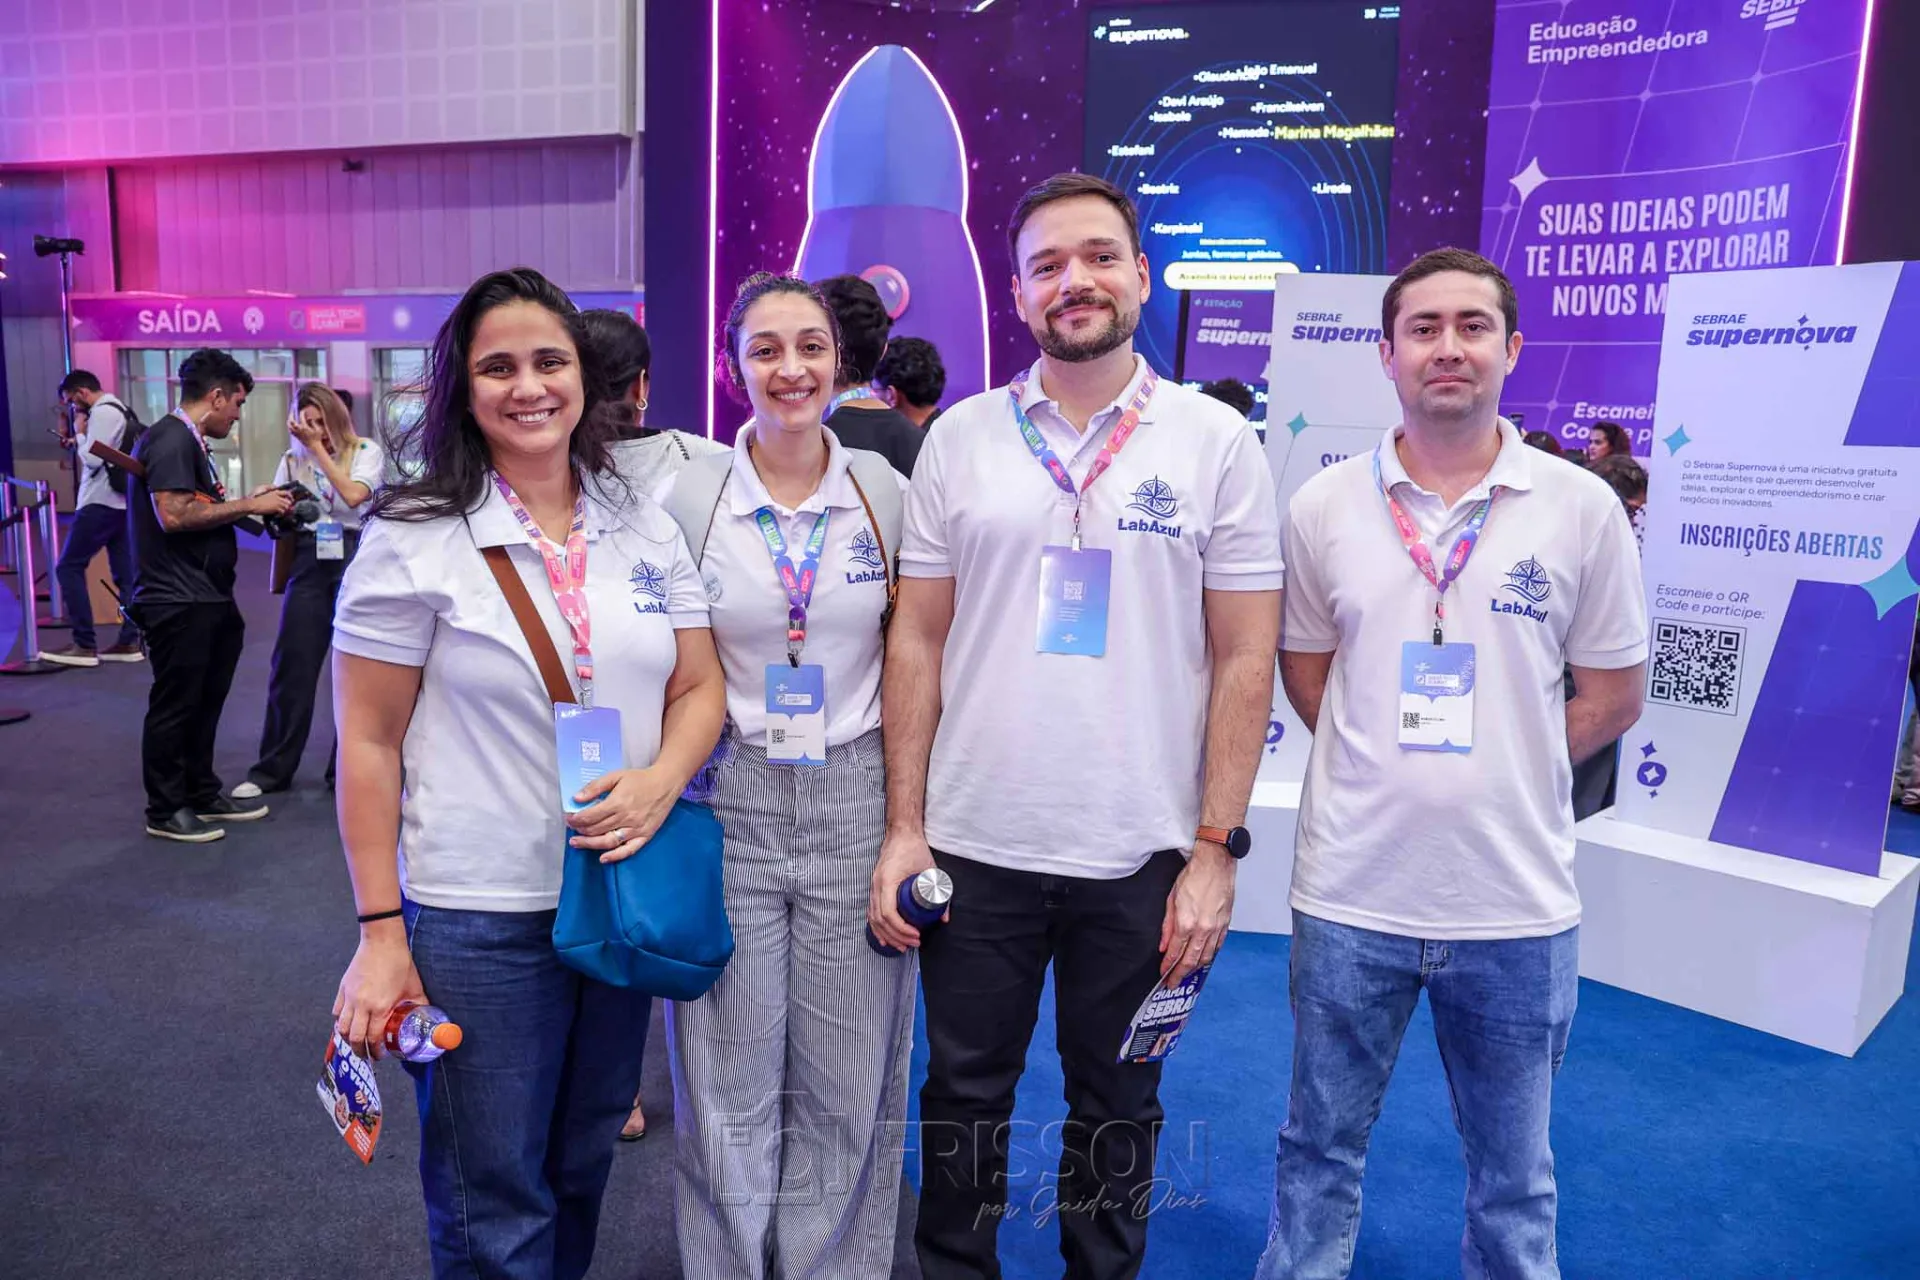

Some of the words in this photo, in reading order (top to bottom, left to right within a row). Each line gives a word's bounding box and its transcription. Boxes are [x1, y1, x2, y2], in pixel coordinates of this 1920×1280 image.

[1529, 16, 1637, 41] Educação
[1527, 30, 1708, 64] Empreendedora
[1274, 125, 1321, 140] Marina
[1538, 202, 1604, 237] SUAS
[1610, 196, 1694, 234] IDEIAS
[1701, 183, 1790, 228] PODEM
[1525, 245, 1551, 277] TE
[1557, 242, 1634, 277] LEVAR
[1640, 241, 1657, 274] A
[1665, 228, 1790, 273] EXPLORAR
[1552, 283, 1637, 317] NOVOS
[138, 304, 222, 334] SAÍDA
[1296, 312, 1343, 323] SEBRAE
[1693, 313, 1747, 324] SEBRAE
[1686, 325, 1857, 348] supernova
[1682, 473, 1702, 482] para
[1703, 472, 1753, 483] estudantes
[1755, 476, 1774, 485] que
[1776, 477, 1813, 487] querem
[1815, 478, 1875, 489] desenvolver
[1693, 460, 1725, 470] Sebrae
[1727, 462, 1777, 473] Supernova
[1811, 466, 1855, 475] iniciativa
[1857, 468, 1898, 478] gratuita
[1680, 495, 1720, 505] negócios
[1710, 485, 1746, 495] explorar
[1757, 487, 1852, 500] empreendedorismo
[1863, 493, 1886, 501] criar
[1117, 518, 1181, 538] LabAzul
[1680, 522, 1790, 557] INSCRIÇÕES
[1794, 531, 1884, 560] ABERTAS
[1657, 584, 1714, 600] Escaneie
[1728, 591, 1750, 603] QR
[1491, 599, 1548, 623] LabAzul
[1655, 597, 1689, 611] Code
[1691, 603, 1700, 611] e
[1702, 604, 1766, 620] participe:
